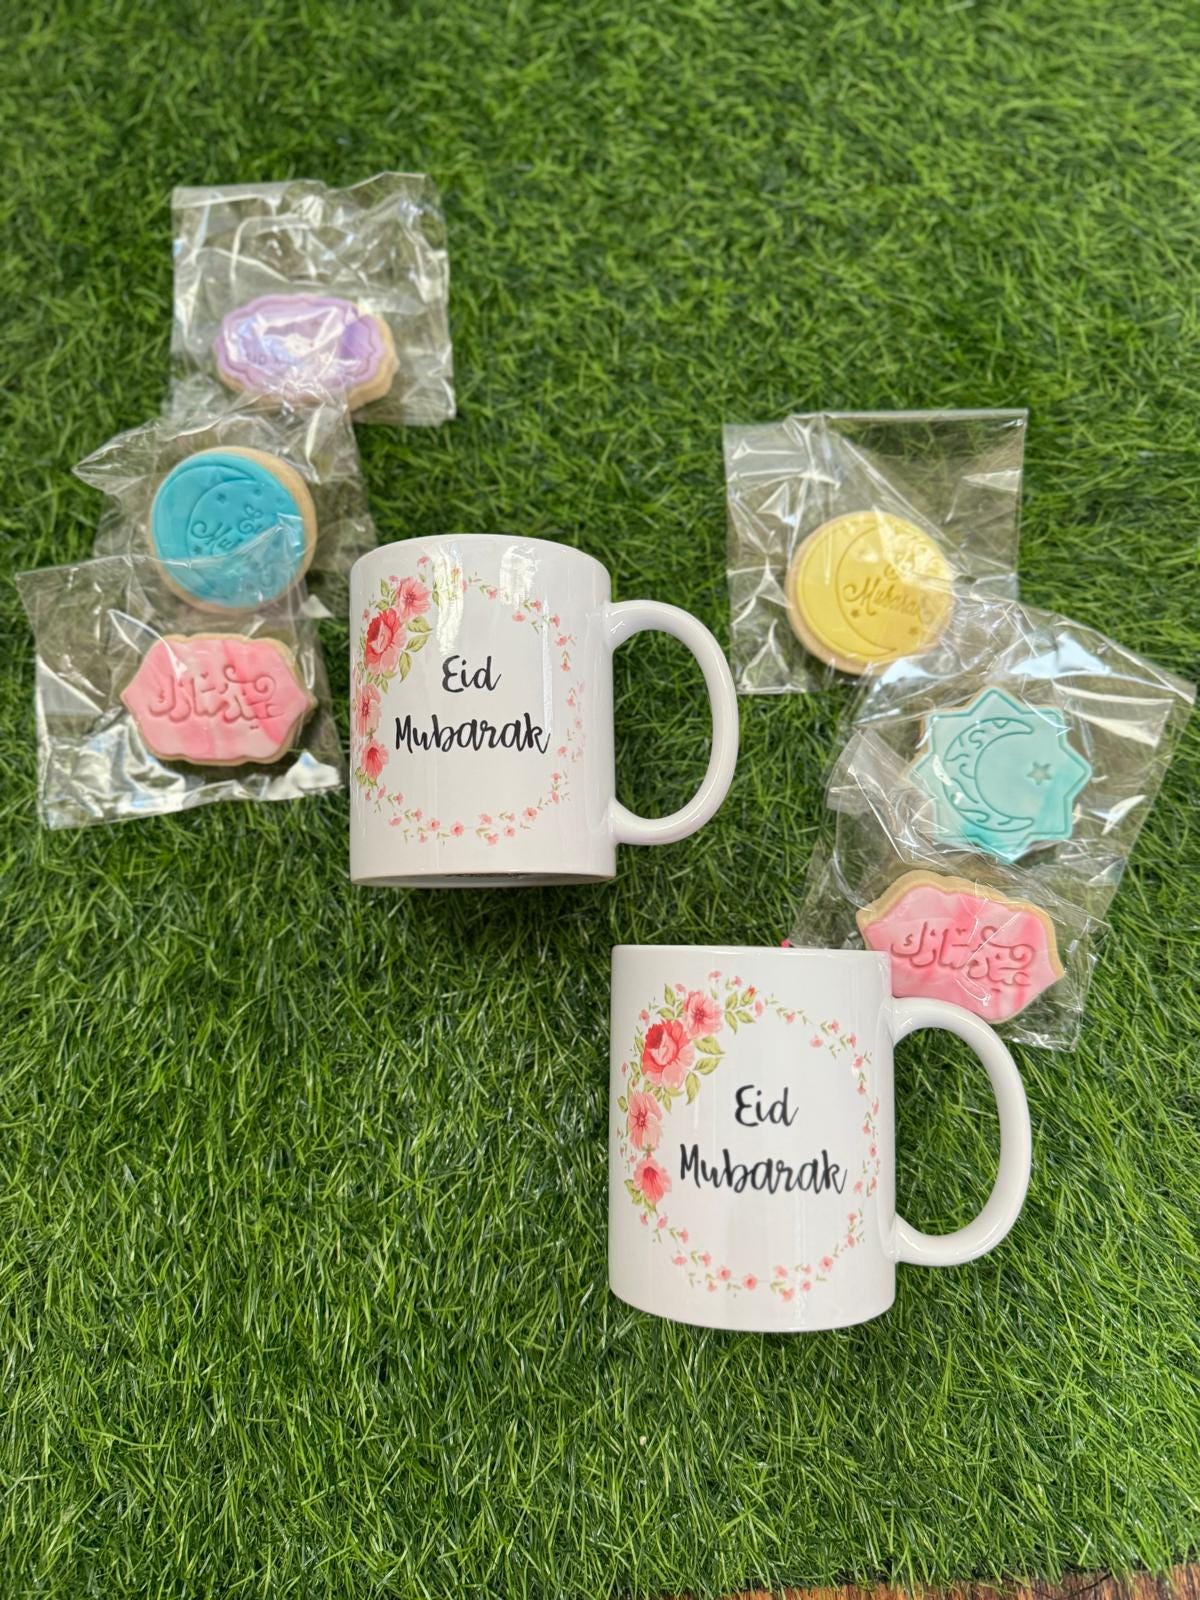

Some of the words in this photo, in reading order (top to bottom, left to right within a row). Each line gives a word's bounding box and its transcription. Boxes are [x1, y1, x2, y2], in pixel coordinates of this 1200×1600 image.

[442, 655, 501, 692] Eid
[395, 712, 550, 754] Mubarak
[734, 1085, 799, 1127] Eid
[679, 1144, 848, 1194] Mubarak
